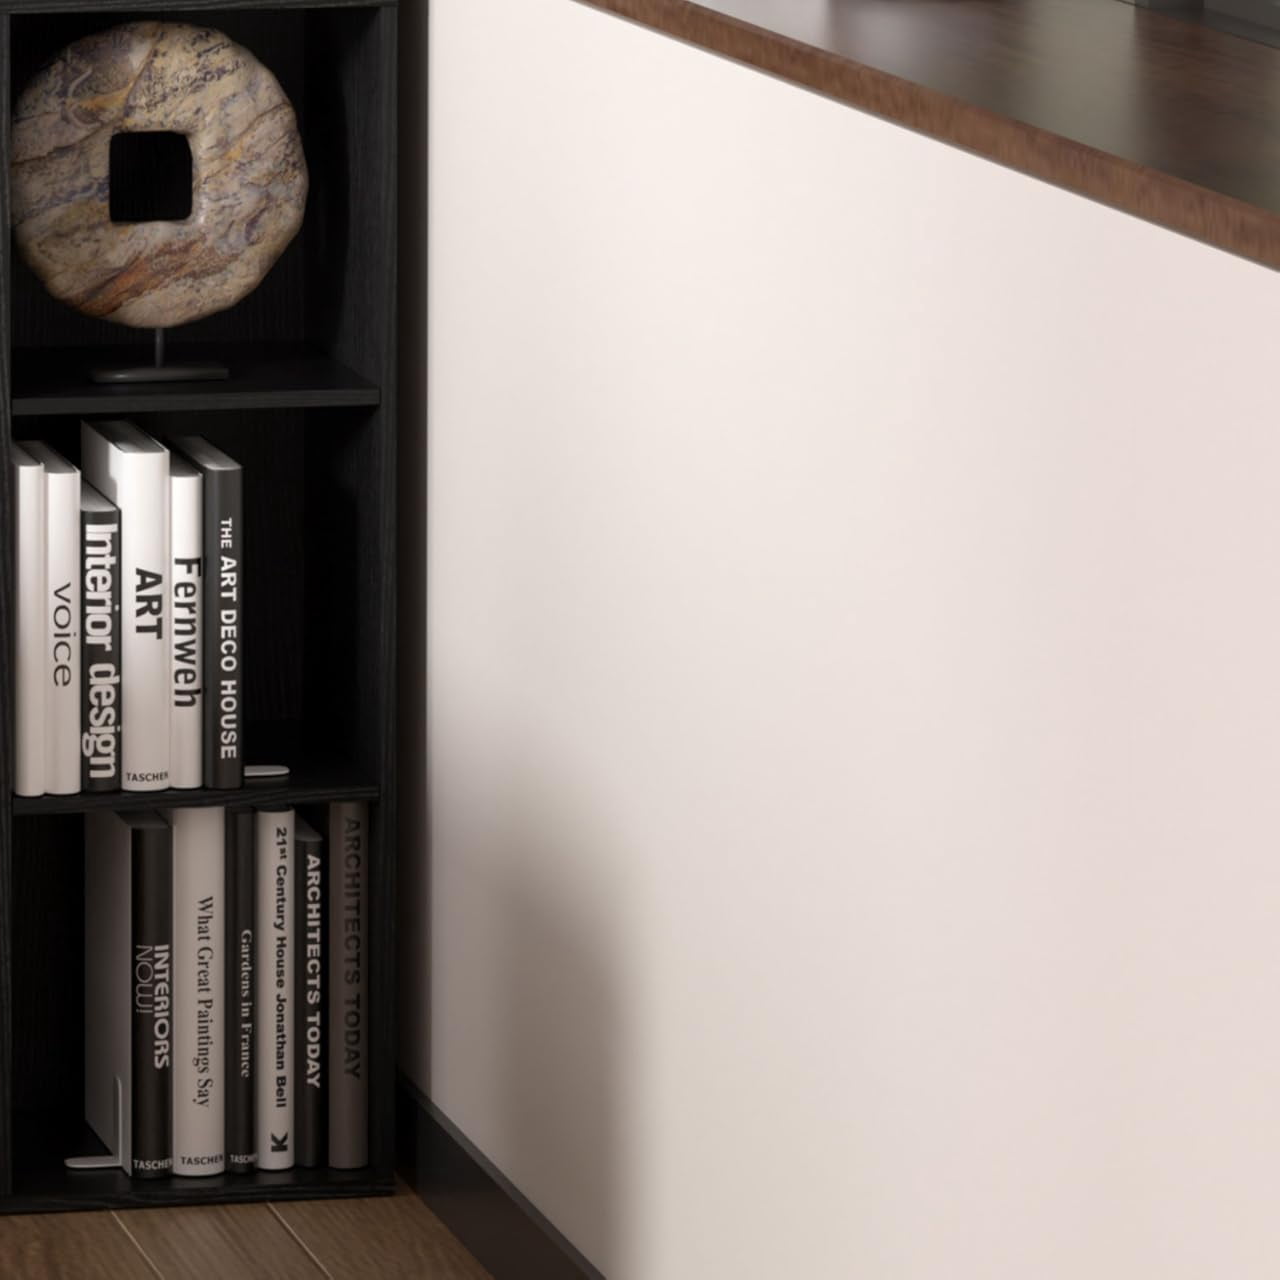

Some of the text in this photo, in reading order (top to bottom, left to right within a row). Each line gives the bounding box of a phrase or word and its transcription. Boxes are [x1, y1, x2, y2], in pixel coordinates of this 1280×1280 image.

[53, 583, 76, 687] voice
[82, 522, 120, 778] Interior design
[135, 568, 164, 640] ART
[174, 558, 202, 707] Fernweh
[220, 518, 238, 760] THE ART DECO HOUSE
[135, 945, 153, 1014] NOW!
[154, 944, 170, 1069] INTERIORS
[193, 896, 214, 1108] What Great Paintings Say
[241, 929, 253, 1078] Gardens in France
[273, 826, 288, 1108] 21st Century House Jonathan Bell
[306, 853, 322, 1089] ARCHITECTS TODAY
[344, 817, 361, 1080] ARCHITECTS TODAY
[271, 1132, 289, 1153] K
